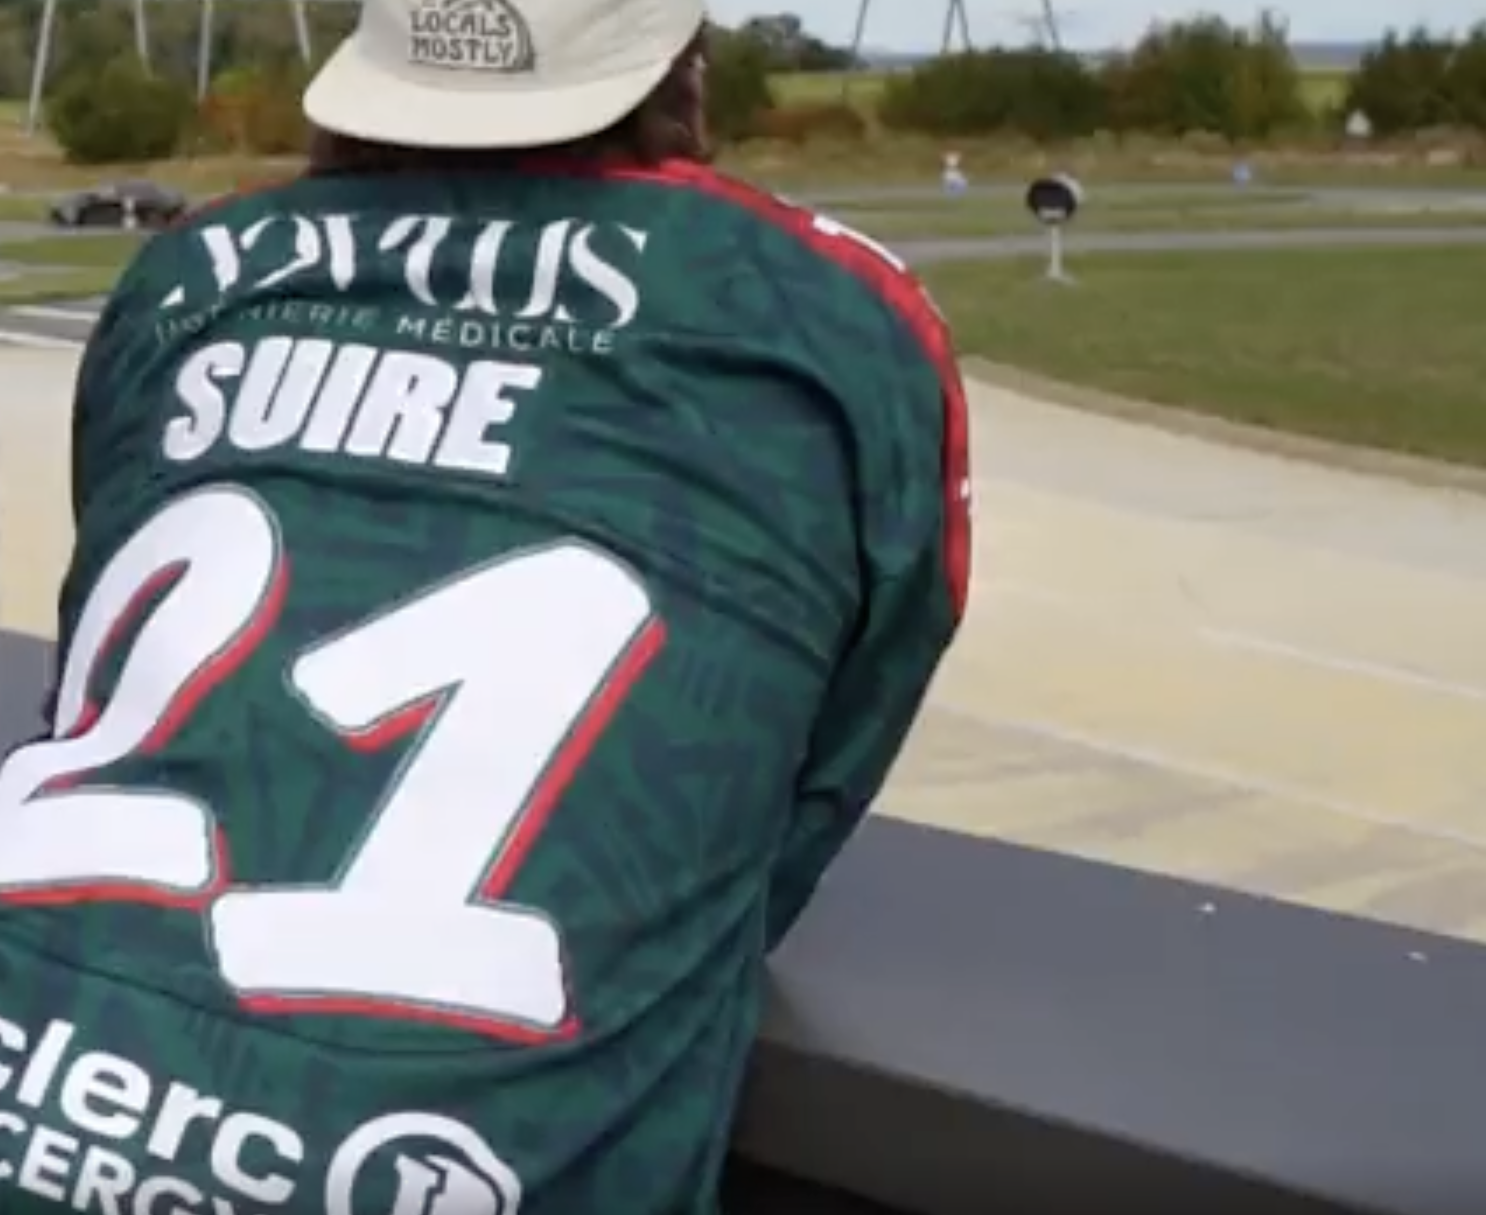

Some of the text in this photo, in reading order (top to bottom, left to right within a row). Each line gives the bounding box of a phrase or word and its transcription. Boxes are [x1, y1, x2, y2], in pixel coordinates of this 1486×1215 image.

[410, 10, 510, 37] LOCALS
[410, 36, 514, 64] MOSTLY
[159, 212, 649, 328] NOVUS
[396, 311, 618, 355] MÉDICALE
[162, 335, 543, 475] SUIRE
